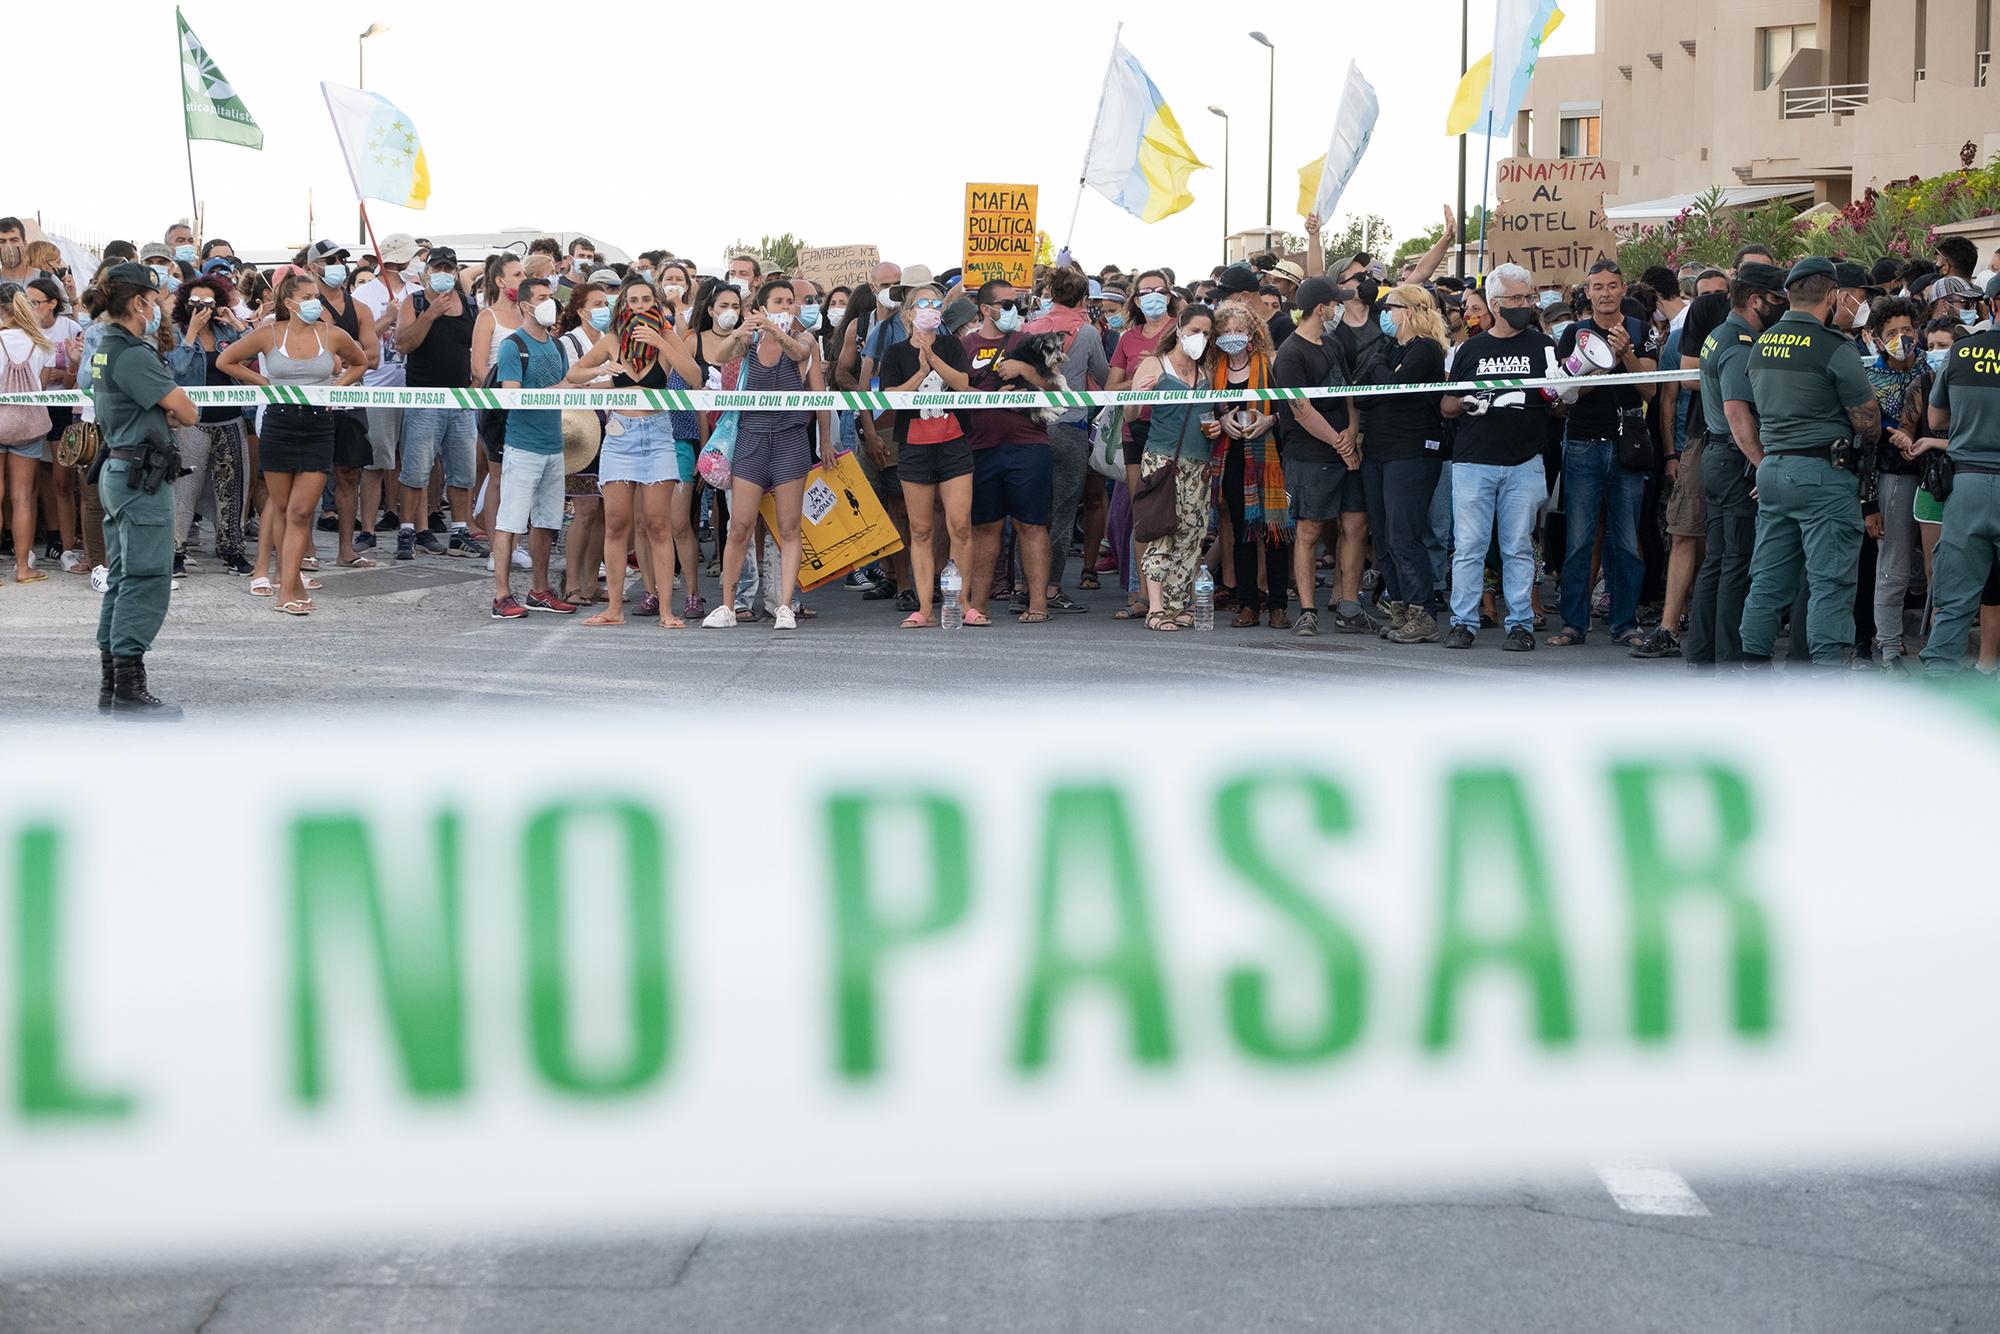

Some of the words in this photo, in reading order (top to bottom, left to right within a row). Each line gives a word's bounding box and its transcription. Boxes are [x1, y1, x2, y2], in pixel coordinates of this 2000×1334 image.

[1532, 184, 1562, 202] AL
[1502, 211, 1576, 232] HOTEL
[1589, 209, 1608, 230] D
[860, 248, 876, 257] NI
[1012, 262, 1024, 272] LA
[1758, 334, 1812, 347] GUARDIA
[1761, 346, 1791, 358] CIVIL
[1958, 346, 2000, 361] GUA
[1478, 356, 1530, 367] SALVAR
[1477, 366, 1491, 374] LA
[188, 391, 210, 402] CIVIL
[212, 391, 225, 402] NO
[228, 391, 257, 402] PASAR
[329, 390, 369, 403] GUARDIA
[372, 392, 396, 404] CIVIL
[399, 392, 413, 404] NO
[414, 393, 446, 405] PASAR
[521, 393, 561, 406] GUARDIA
[564, 394, 587, 406] CIVIL
[590, 394, 604, 406] NO
[606, 394, 637, 406] PASAR
[715, 395, 756, 407] GUARDIA
[759, 395, 782, 407] CIVIL
[785, 395, 800, 407] NO
[802, 395, 835, 407] PASAR
[912, 394, 955, 406] GUARDIA
[958, 394, 982, 405] CIVIL
[985, 394, 1000, 405] NO
[1002, 393, 1036, 404] PASAR
[1117, 391, 1161, 401] GUARDIA
[1164, 391, 1189, 400] CIVIL
[1192, 390, 1207, 399] NO
[1209, 389, 1243, 398] PASAR
[284, 804, 680, 1112] NO
[820, 756, 1784, 1090] PASAR
